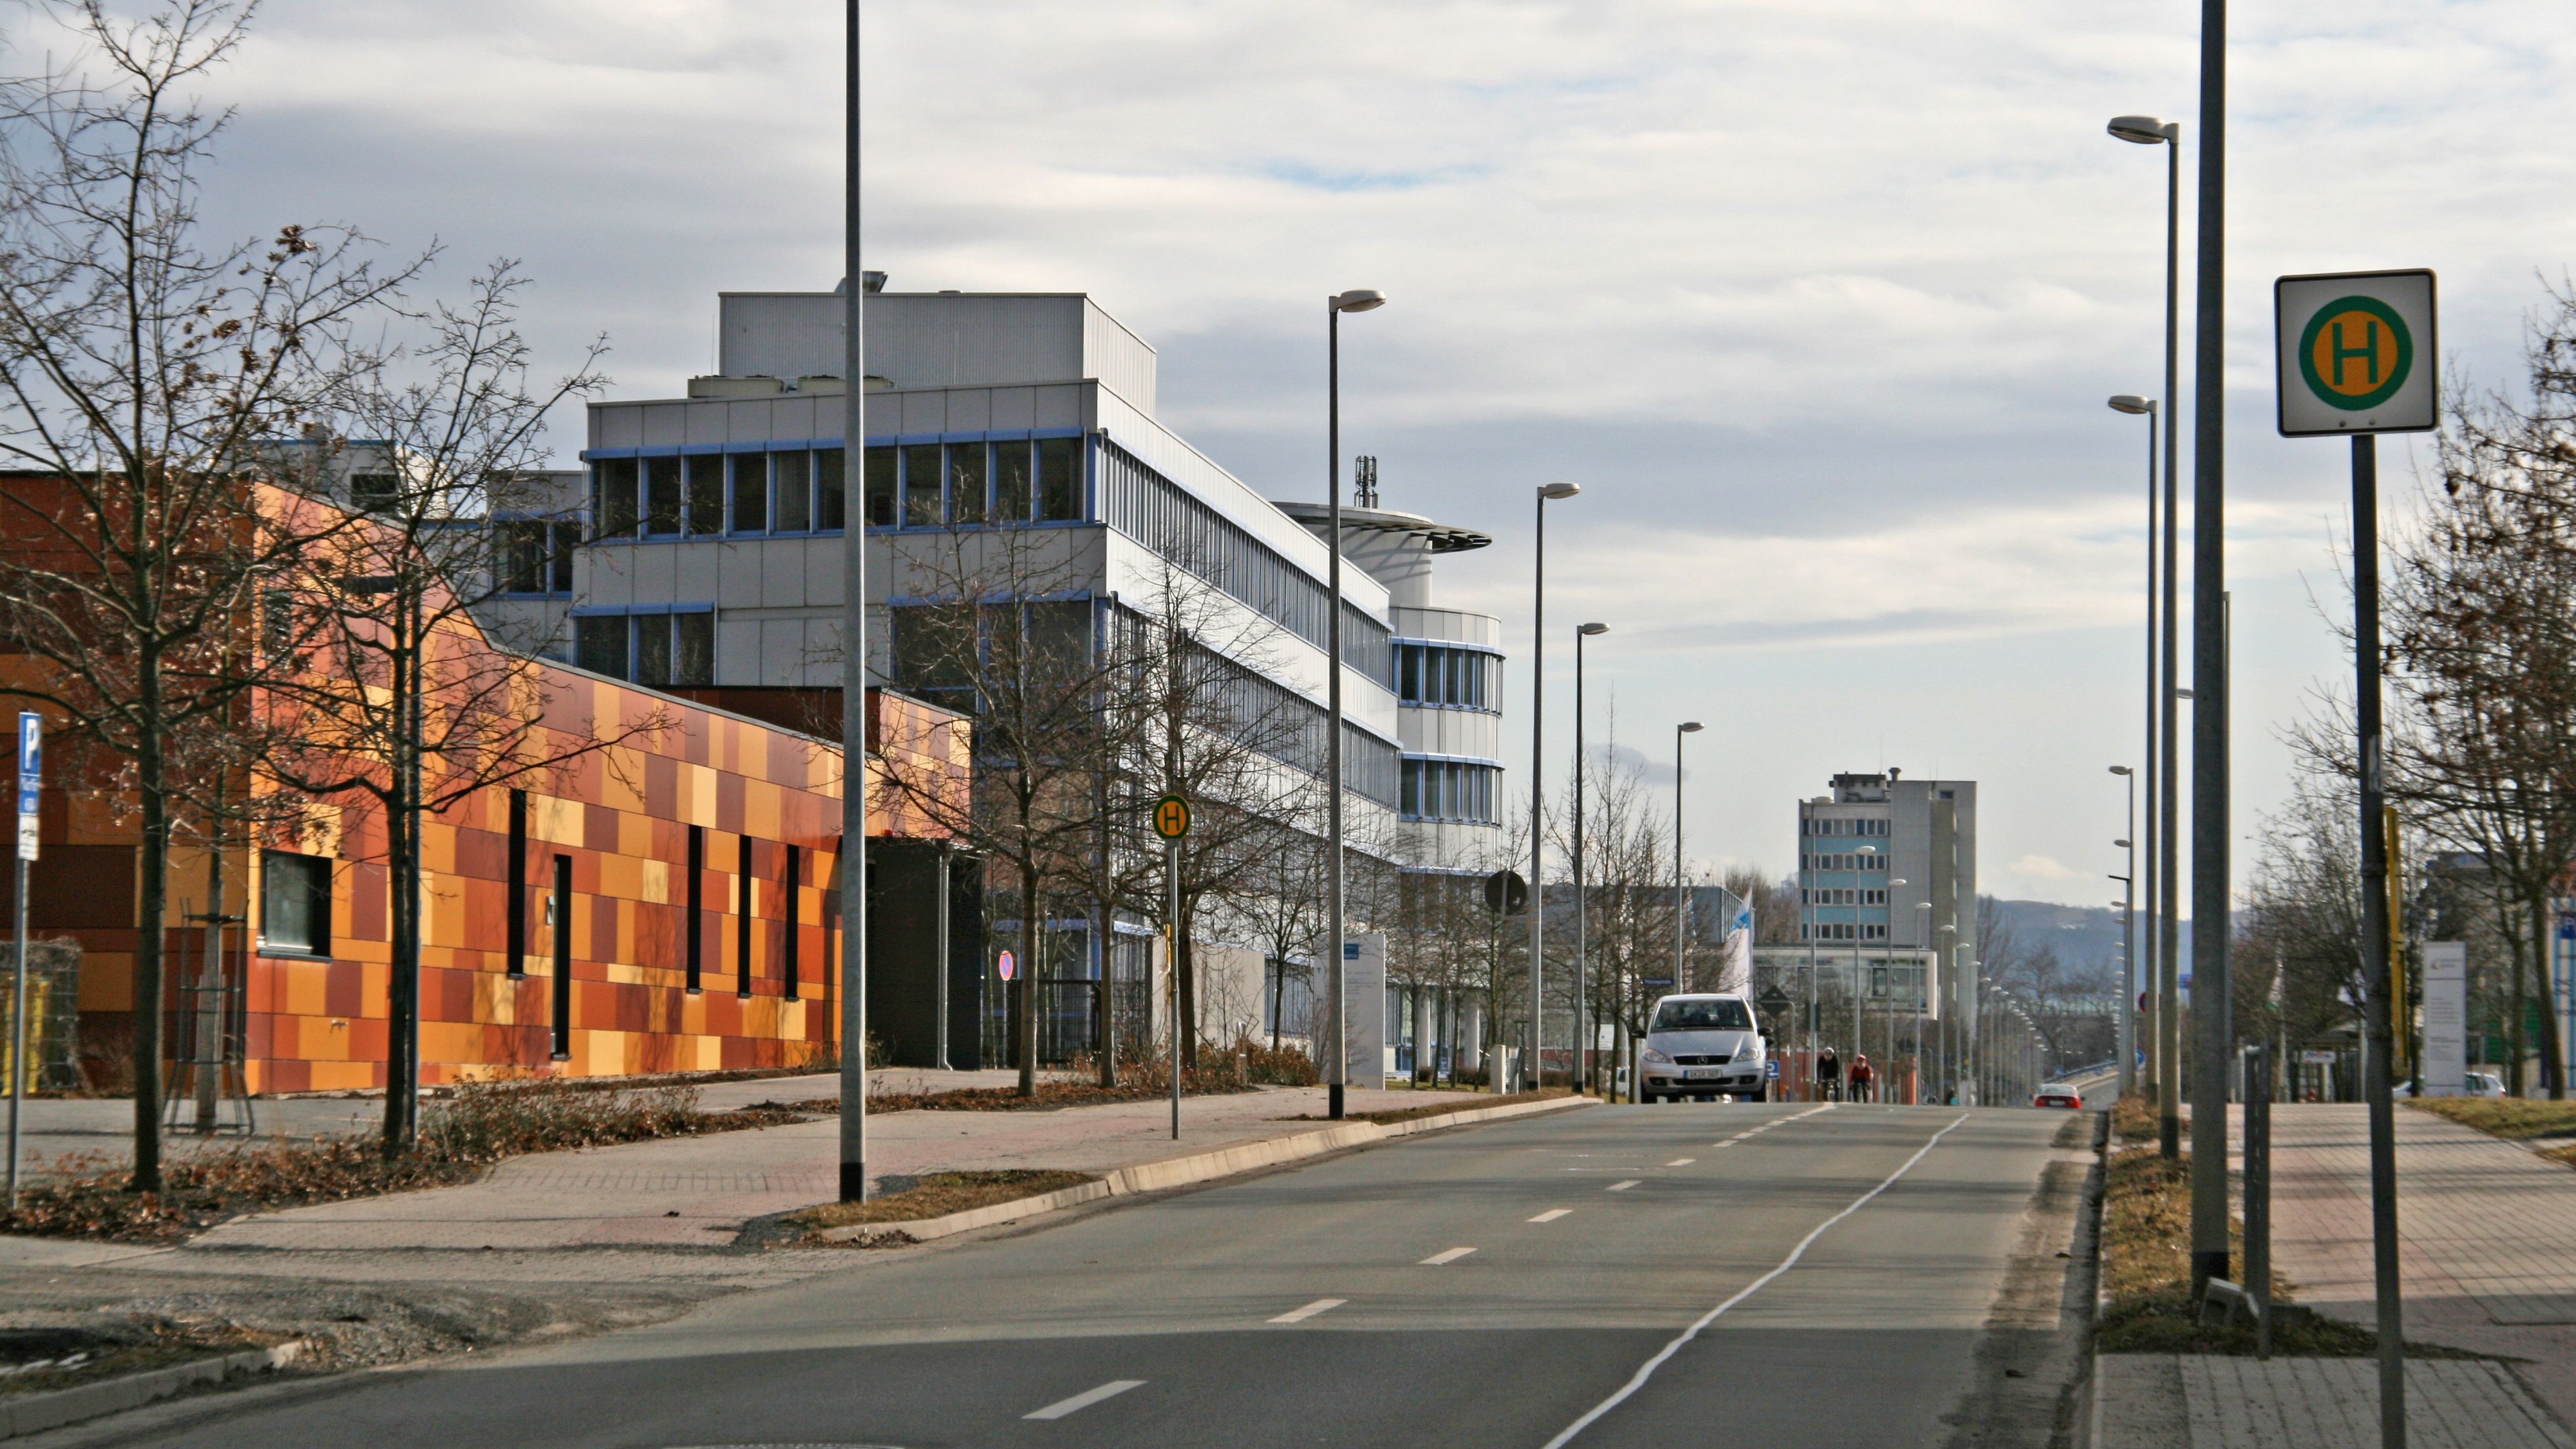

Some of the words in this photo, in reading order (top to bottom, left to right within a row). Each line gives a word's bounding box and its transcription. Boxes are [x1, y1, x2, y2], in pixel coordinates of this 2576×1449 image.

[2332, 320, 2379, 386] H
[25, 719, 38, 769] P
[1163, 805, 1180, 832] H
